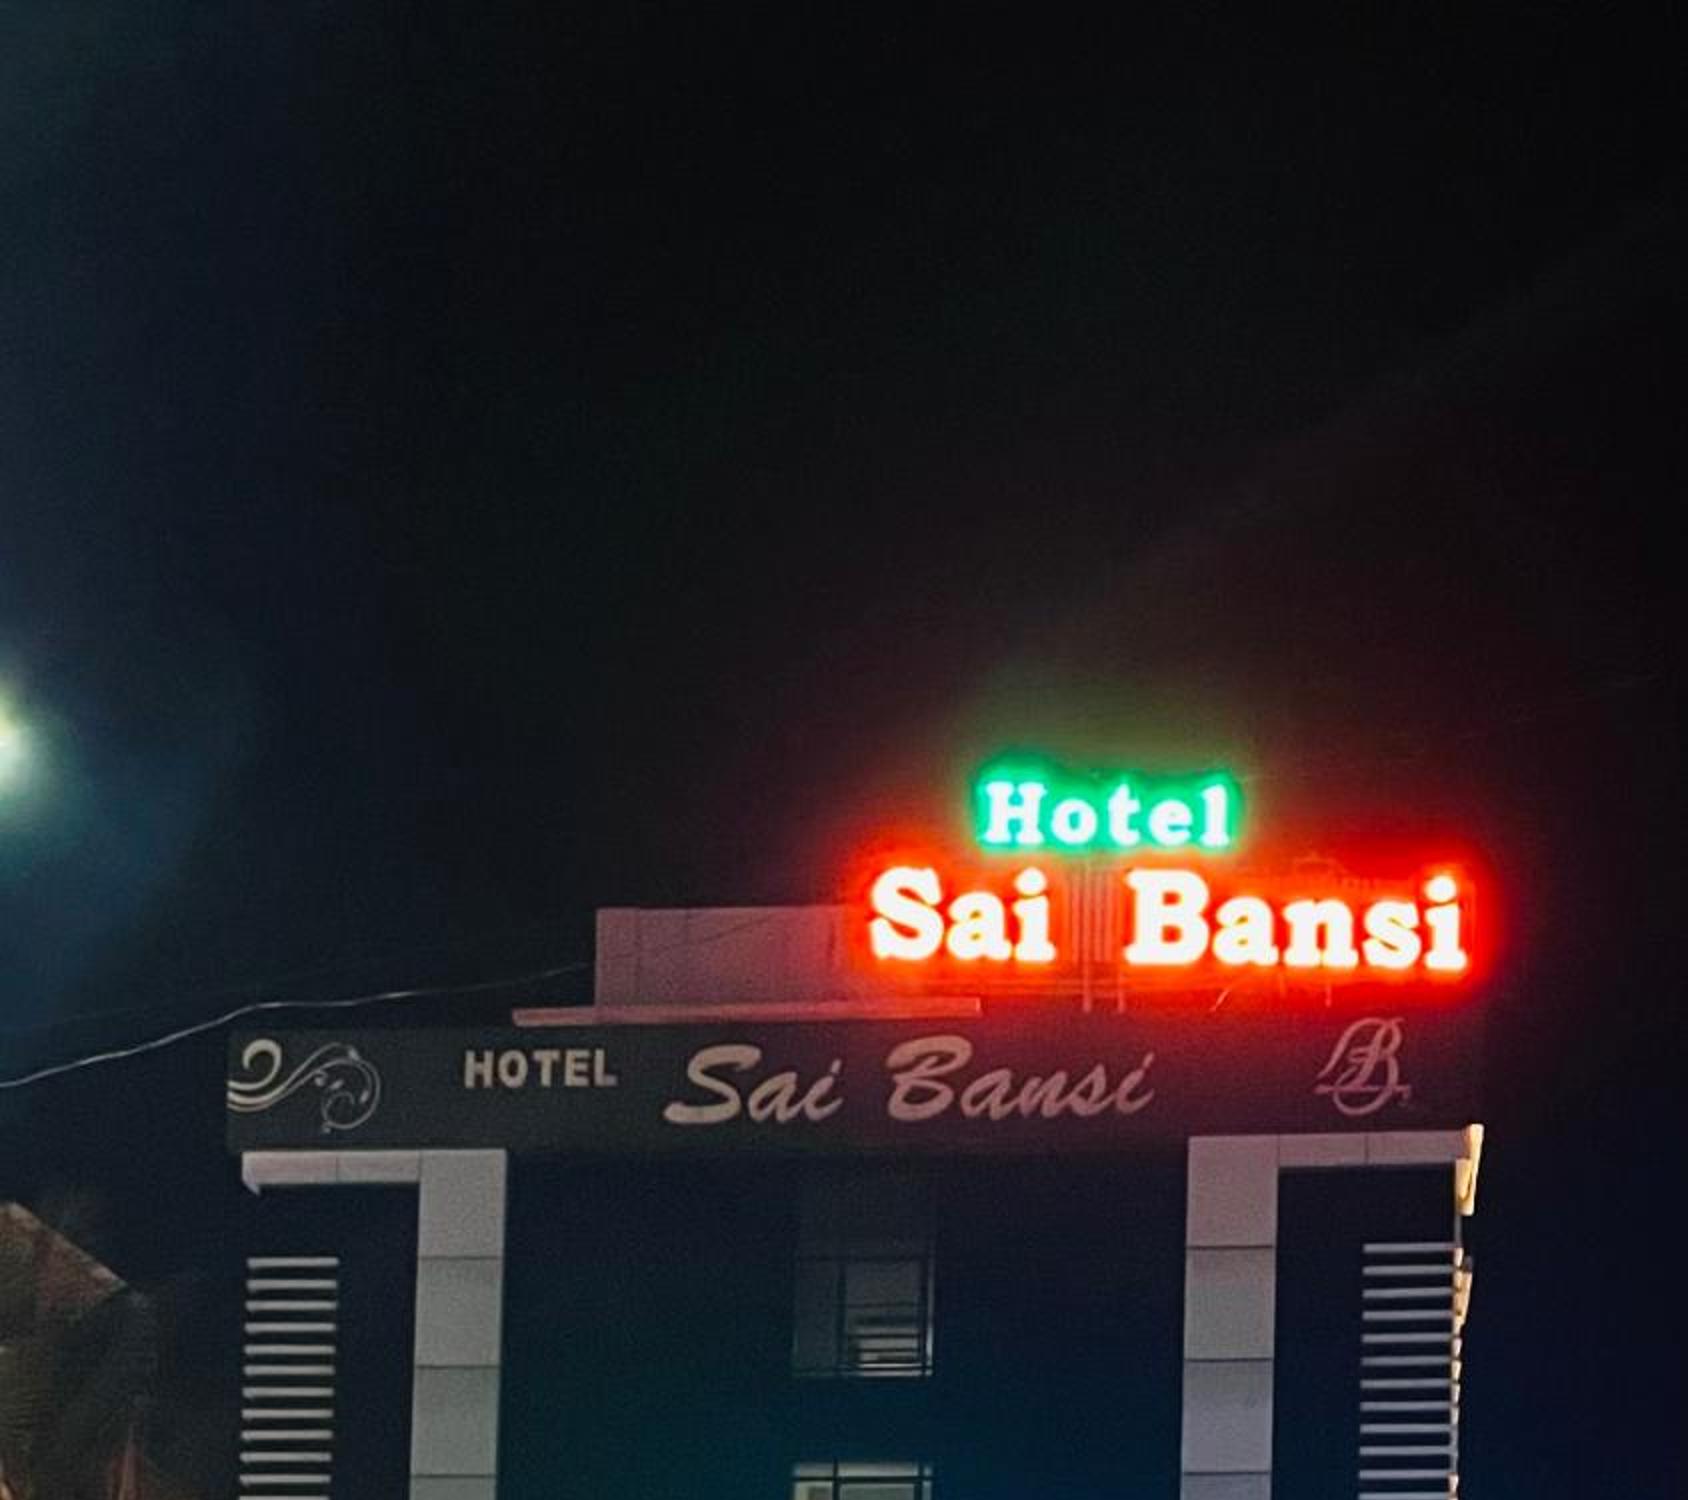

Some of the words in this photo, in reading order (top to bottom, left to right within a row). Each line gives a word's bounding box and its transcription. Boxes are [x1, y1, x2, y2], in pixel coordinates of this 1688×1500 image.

[981, 780, 1230, 846] Hotel
[869, 866, 1055, 963] Sai
[1125, 867, 1467, 970] Bansi
[464, 1049, 618, 1089] HOTEL
[663, 1044, 844, 1124] Sai
[885, 1035, 1156, 1121] Bansi
